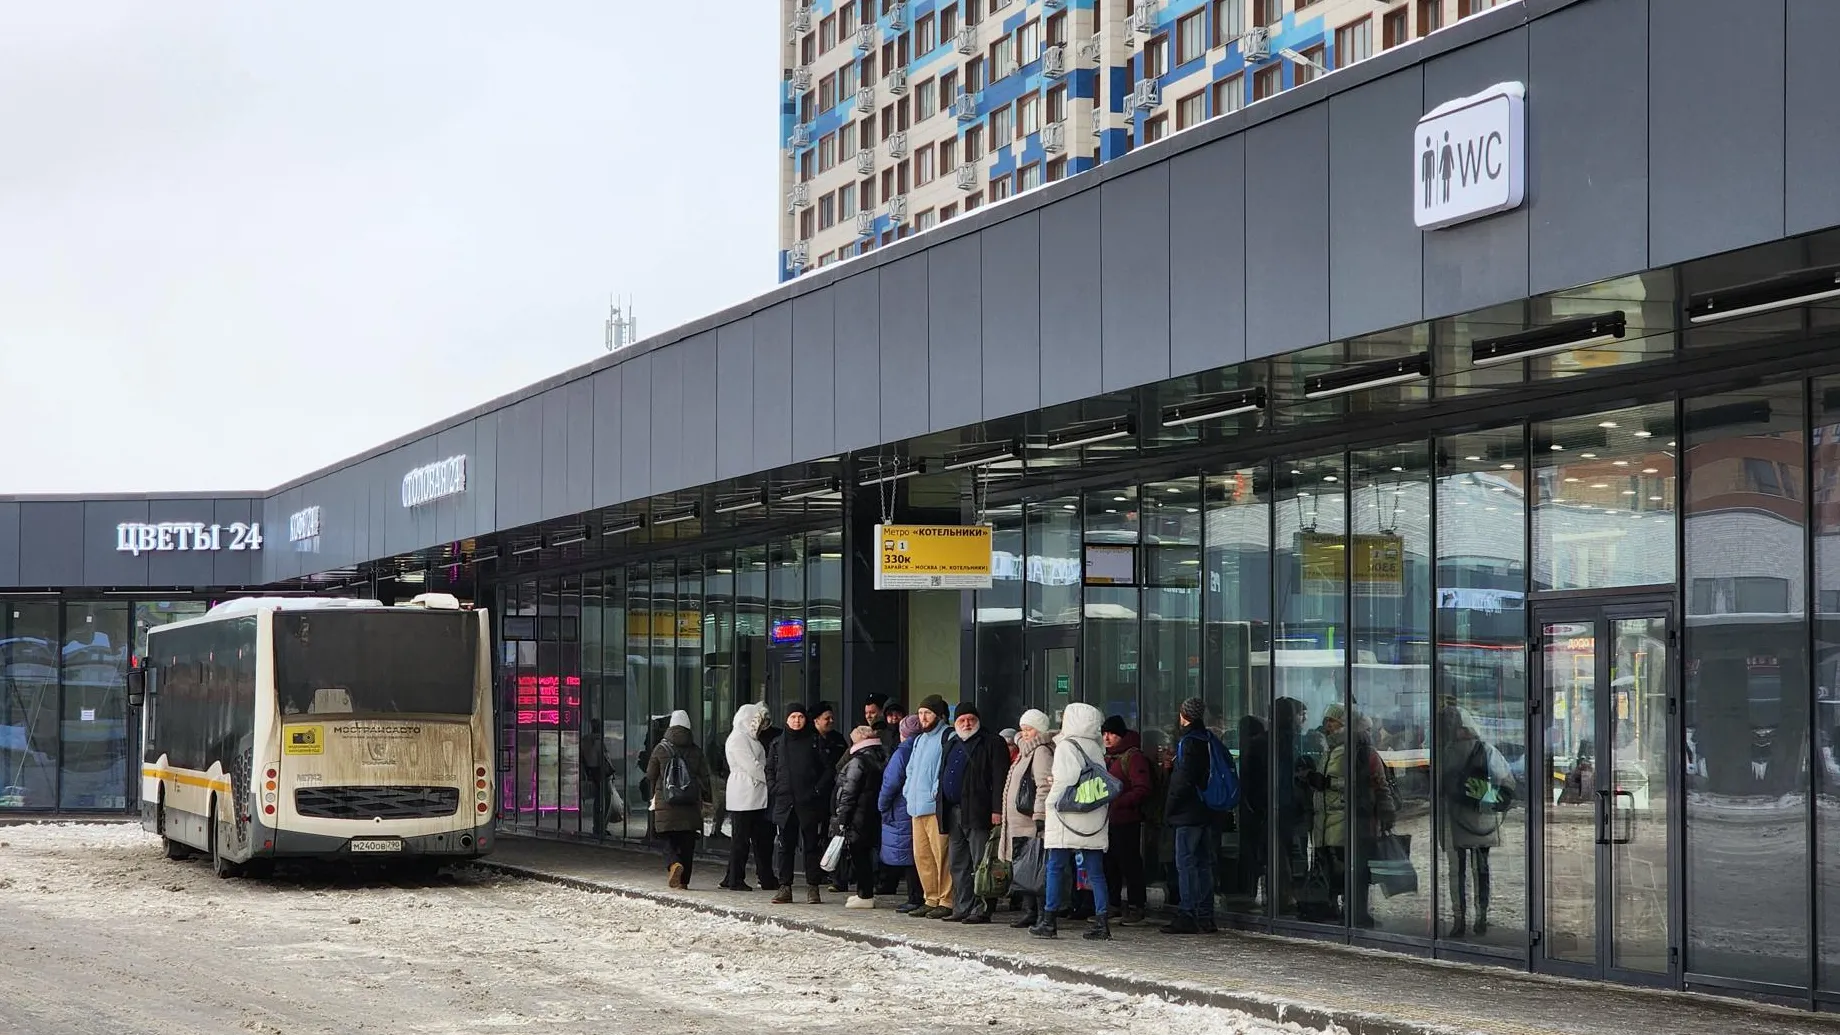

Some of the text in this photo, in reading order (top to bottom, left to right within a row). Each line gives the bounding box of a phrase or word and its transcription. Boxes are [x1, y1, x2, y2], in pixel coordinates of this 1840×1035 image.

[1457, 130, 1503, 188] WC
[402, 456, 463, 507] СТОЛОВАЯ 24
[116, 522, 263, 556] ЦВЕТЫ 24
[883, 528, 910, 537] Метро
[884, 554, 911, 564] 330к
[1074, 776, 1109, 804] NIKE
